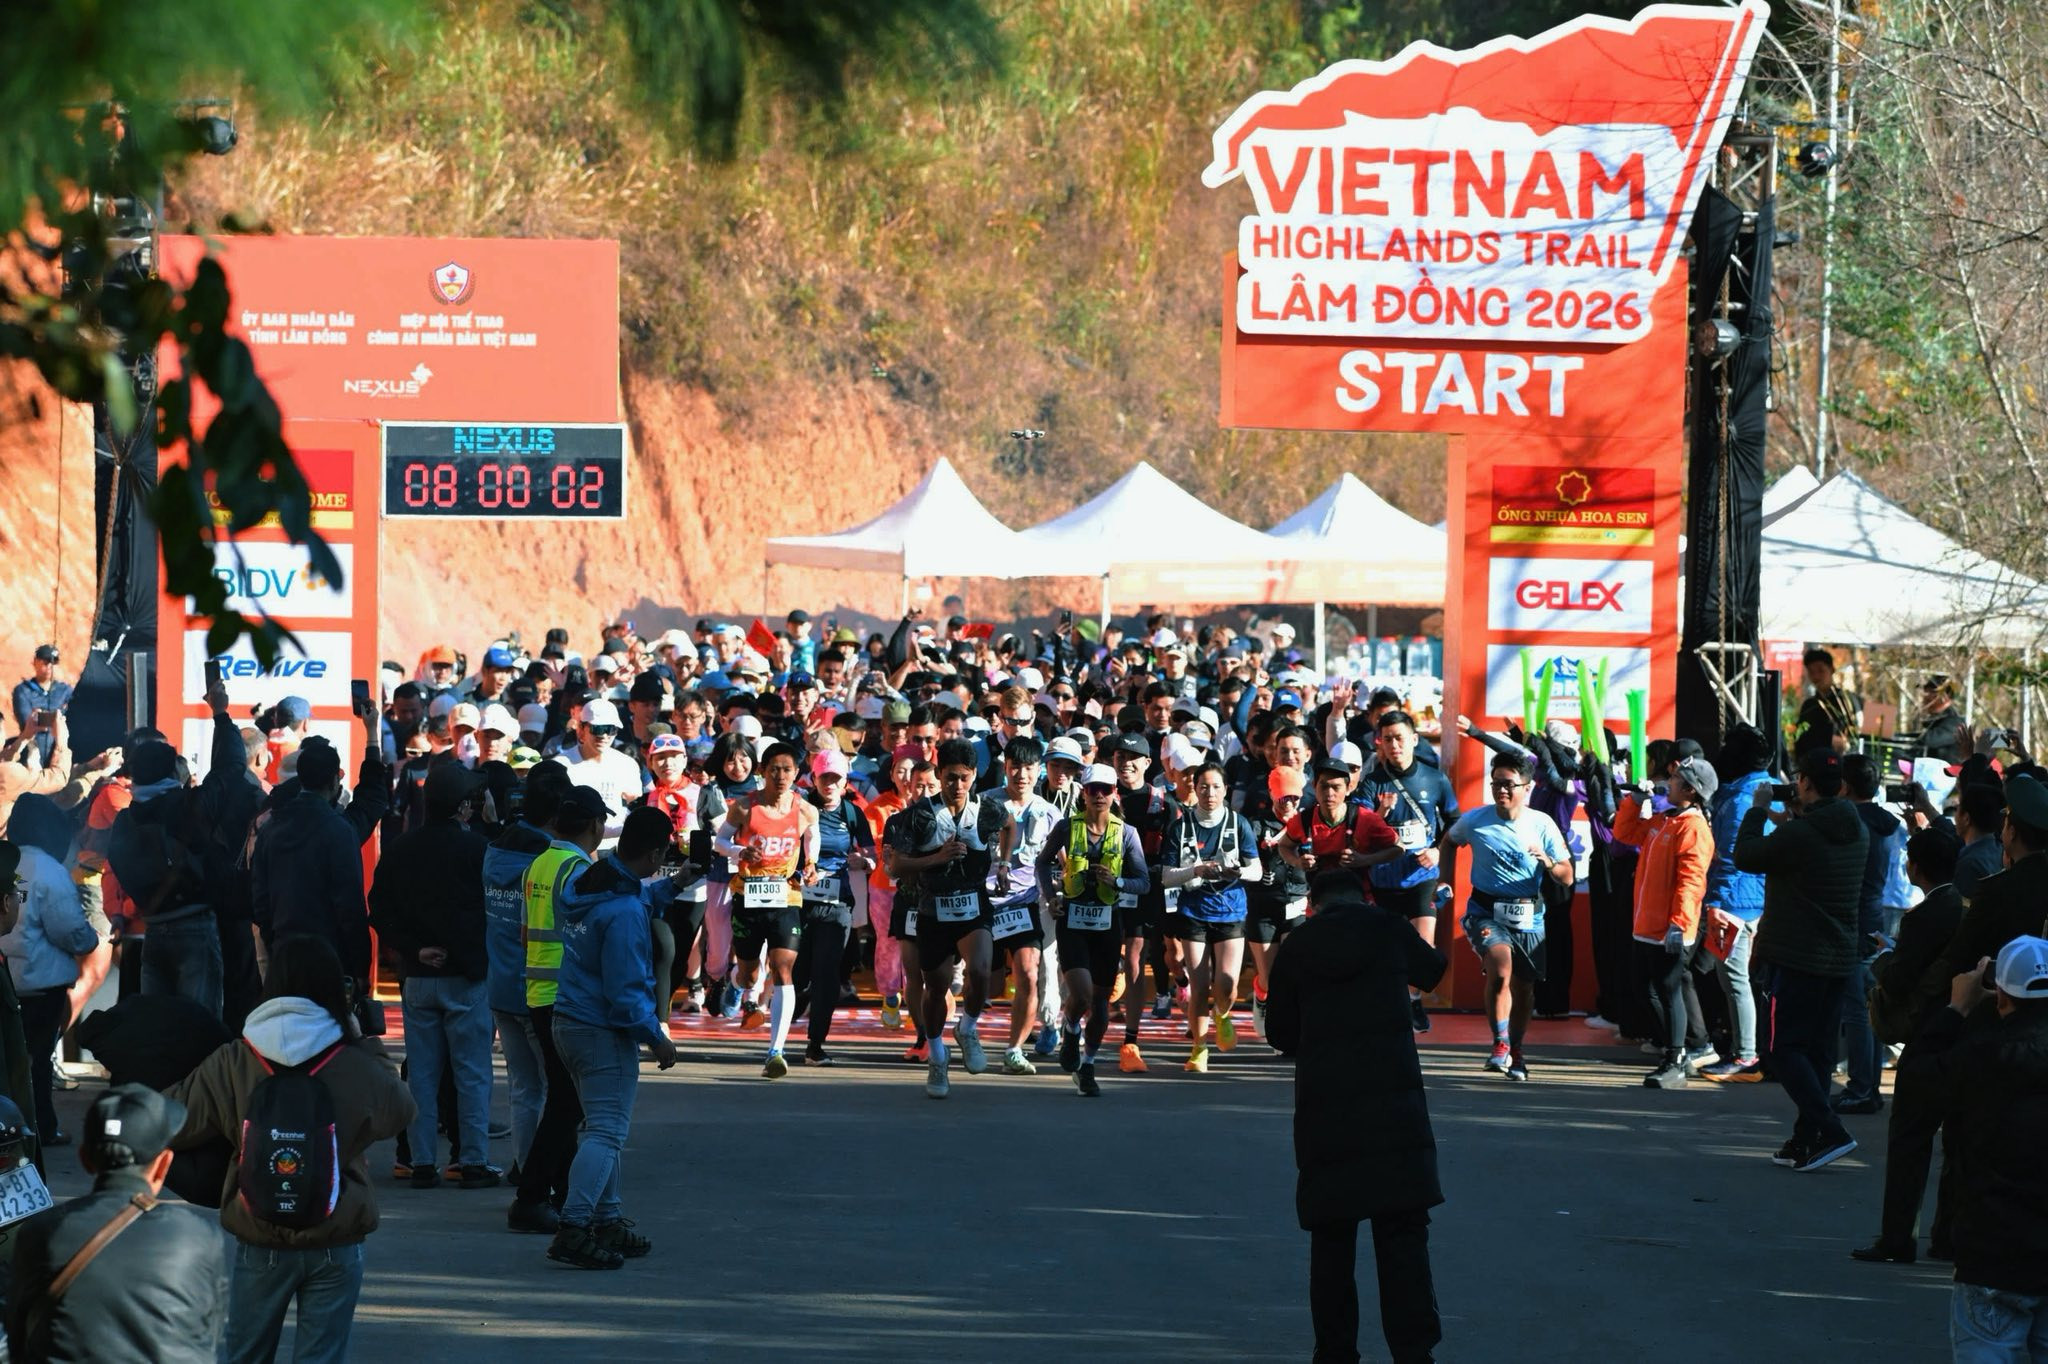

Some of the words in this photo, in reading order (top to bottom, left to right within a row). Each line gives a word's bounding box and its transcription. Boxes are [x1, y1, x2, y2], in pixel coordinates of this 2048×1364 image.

[1252, 146, 1645, 221] VIETNAM
[1253, 225, 1500, 264] HIGHLANDS
[1516, 232, 1641, 268] TRAIL
[1252, 273, 1357, 322] LÂM
[1373, 267, 1510, 327] ĐỒNG
[1526, 289, 1642, 330] 2026
[261, 313, 288, 327] BAN
[291, 311, 325, 327] NHÂN
[328, 311, 355, 327] DÂN
[281, 328, 309, 344] LÂM
[367, 330, 399, 345] CÔNG
[402, 332, 418, 345] AN
[421, 329, 453, 345] NHÂN
[456, 331, 480, 346] DÂN
[483, 331, 507, 349] VIỆT
[509, 333, 537, 346] NAM
[343, 379, 420, 397] NEXUS
[1335, 350, 1585, 417] START
[454, 427, 556, 454] NEXUS
[404, 463, 458, 508] 08
[478, 463, 531, 509] 00
[552, 465, 604, 509] 02
[1498, 505, 1532, 521] ỐNG
[1535, 509, 1577, 525] NHỰA
[1581, 511, 1613, 523] HOA
[1616, 512, 1648, 524] SEN
[213, 568, 297, 598] BIDV
[1516, 579, 1625, 612] GELEX
[748, 884, 781, 894] M1303
[940, 896, 973, 908] M1391
[1074, 906, 1104, 918] F1407
[1503, 905, 1524, 916] 1420
